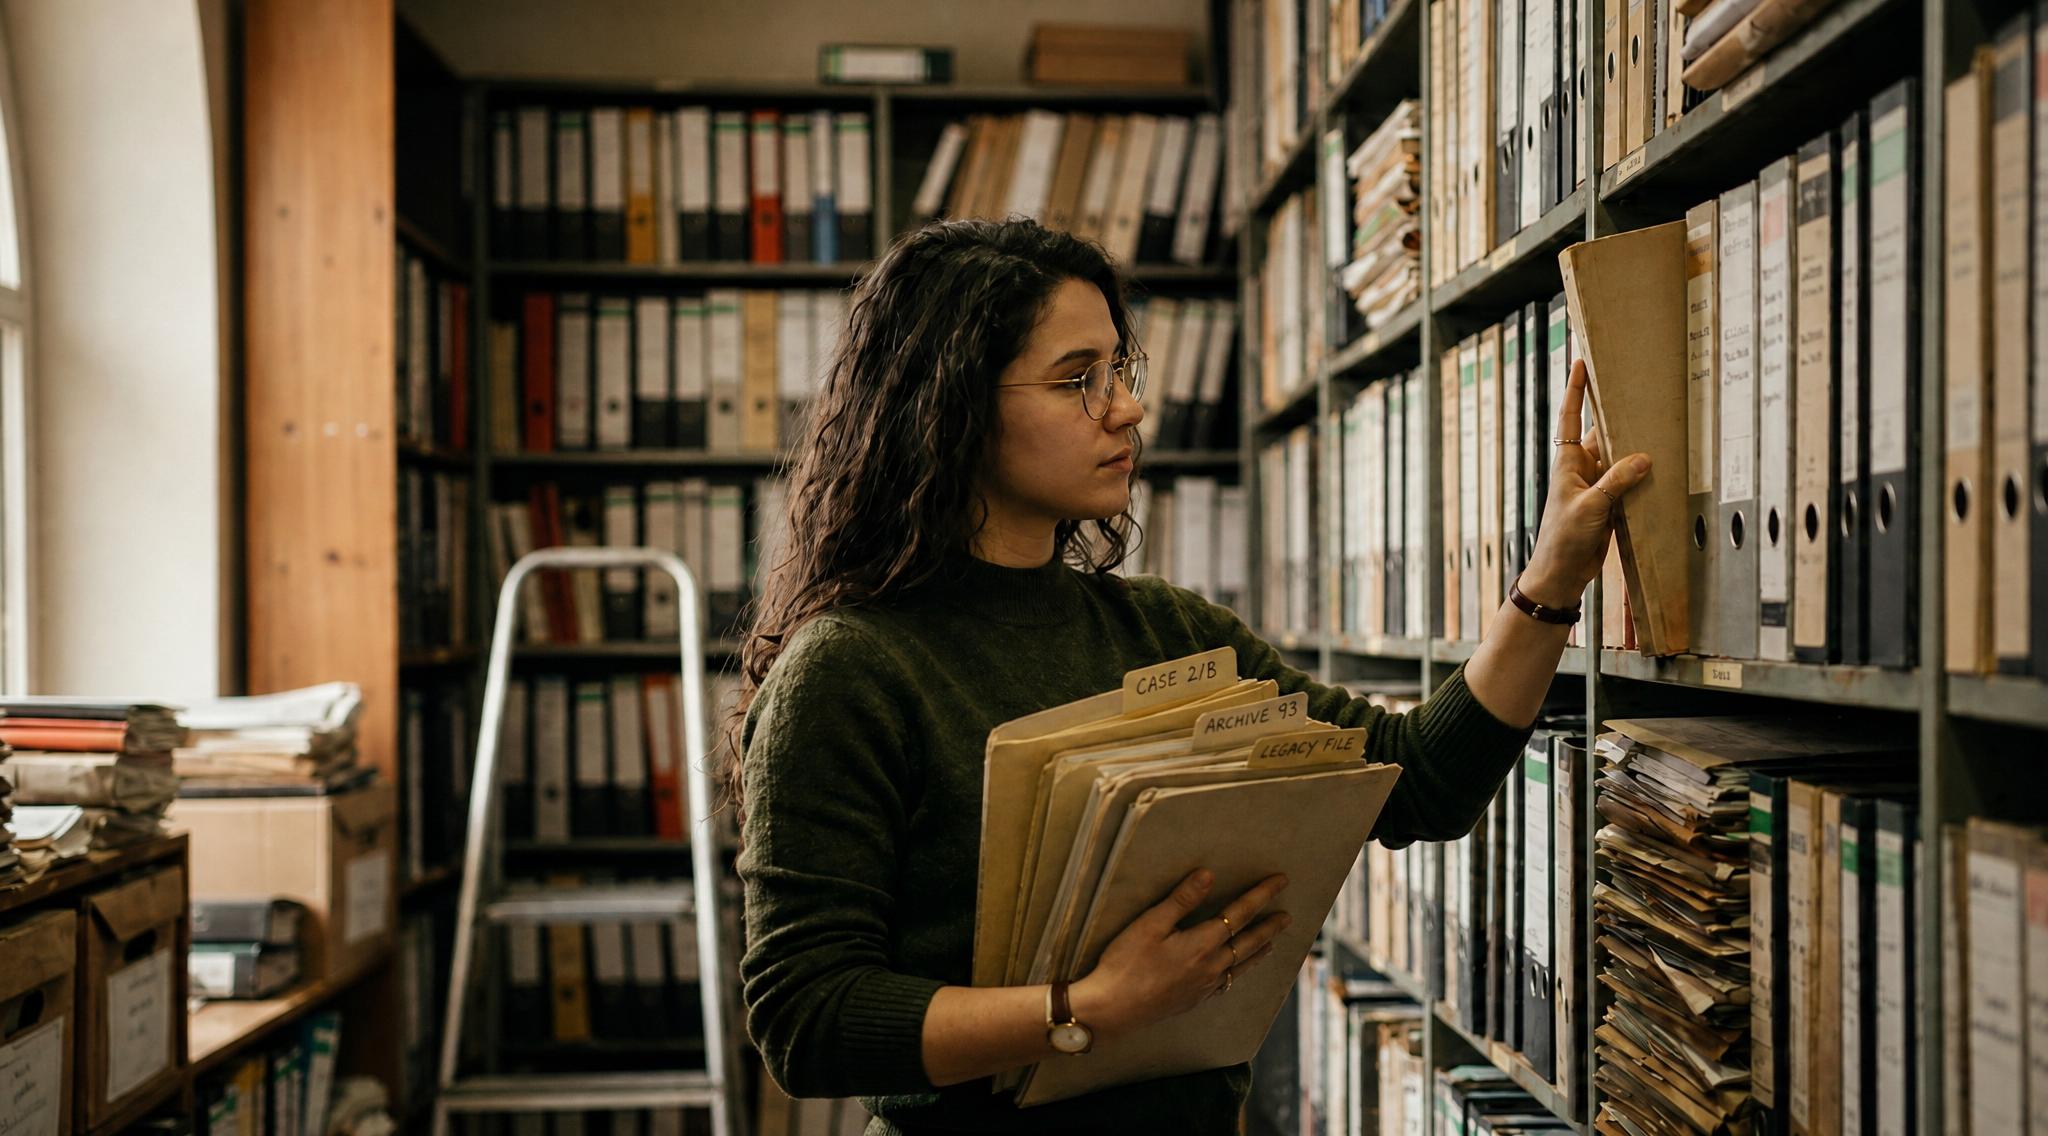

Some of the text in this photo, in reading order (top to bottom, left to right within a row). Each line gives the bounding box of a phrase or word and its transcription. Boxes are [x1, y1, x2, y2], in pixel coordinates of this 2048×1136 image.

[1136, 661, 1217, 695] CASE 2/B
[1204, 701, 1298, 734] ARCHIVE 93
[1260, 737, 1354, 760] LEGACY FILE
